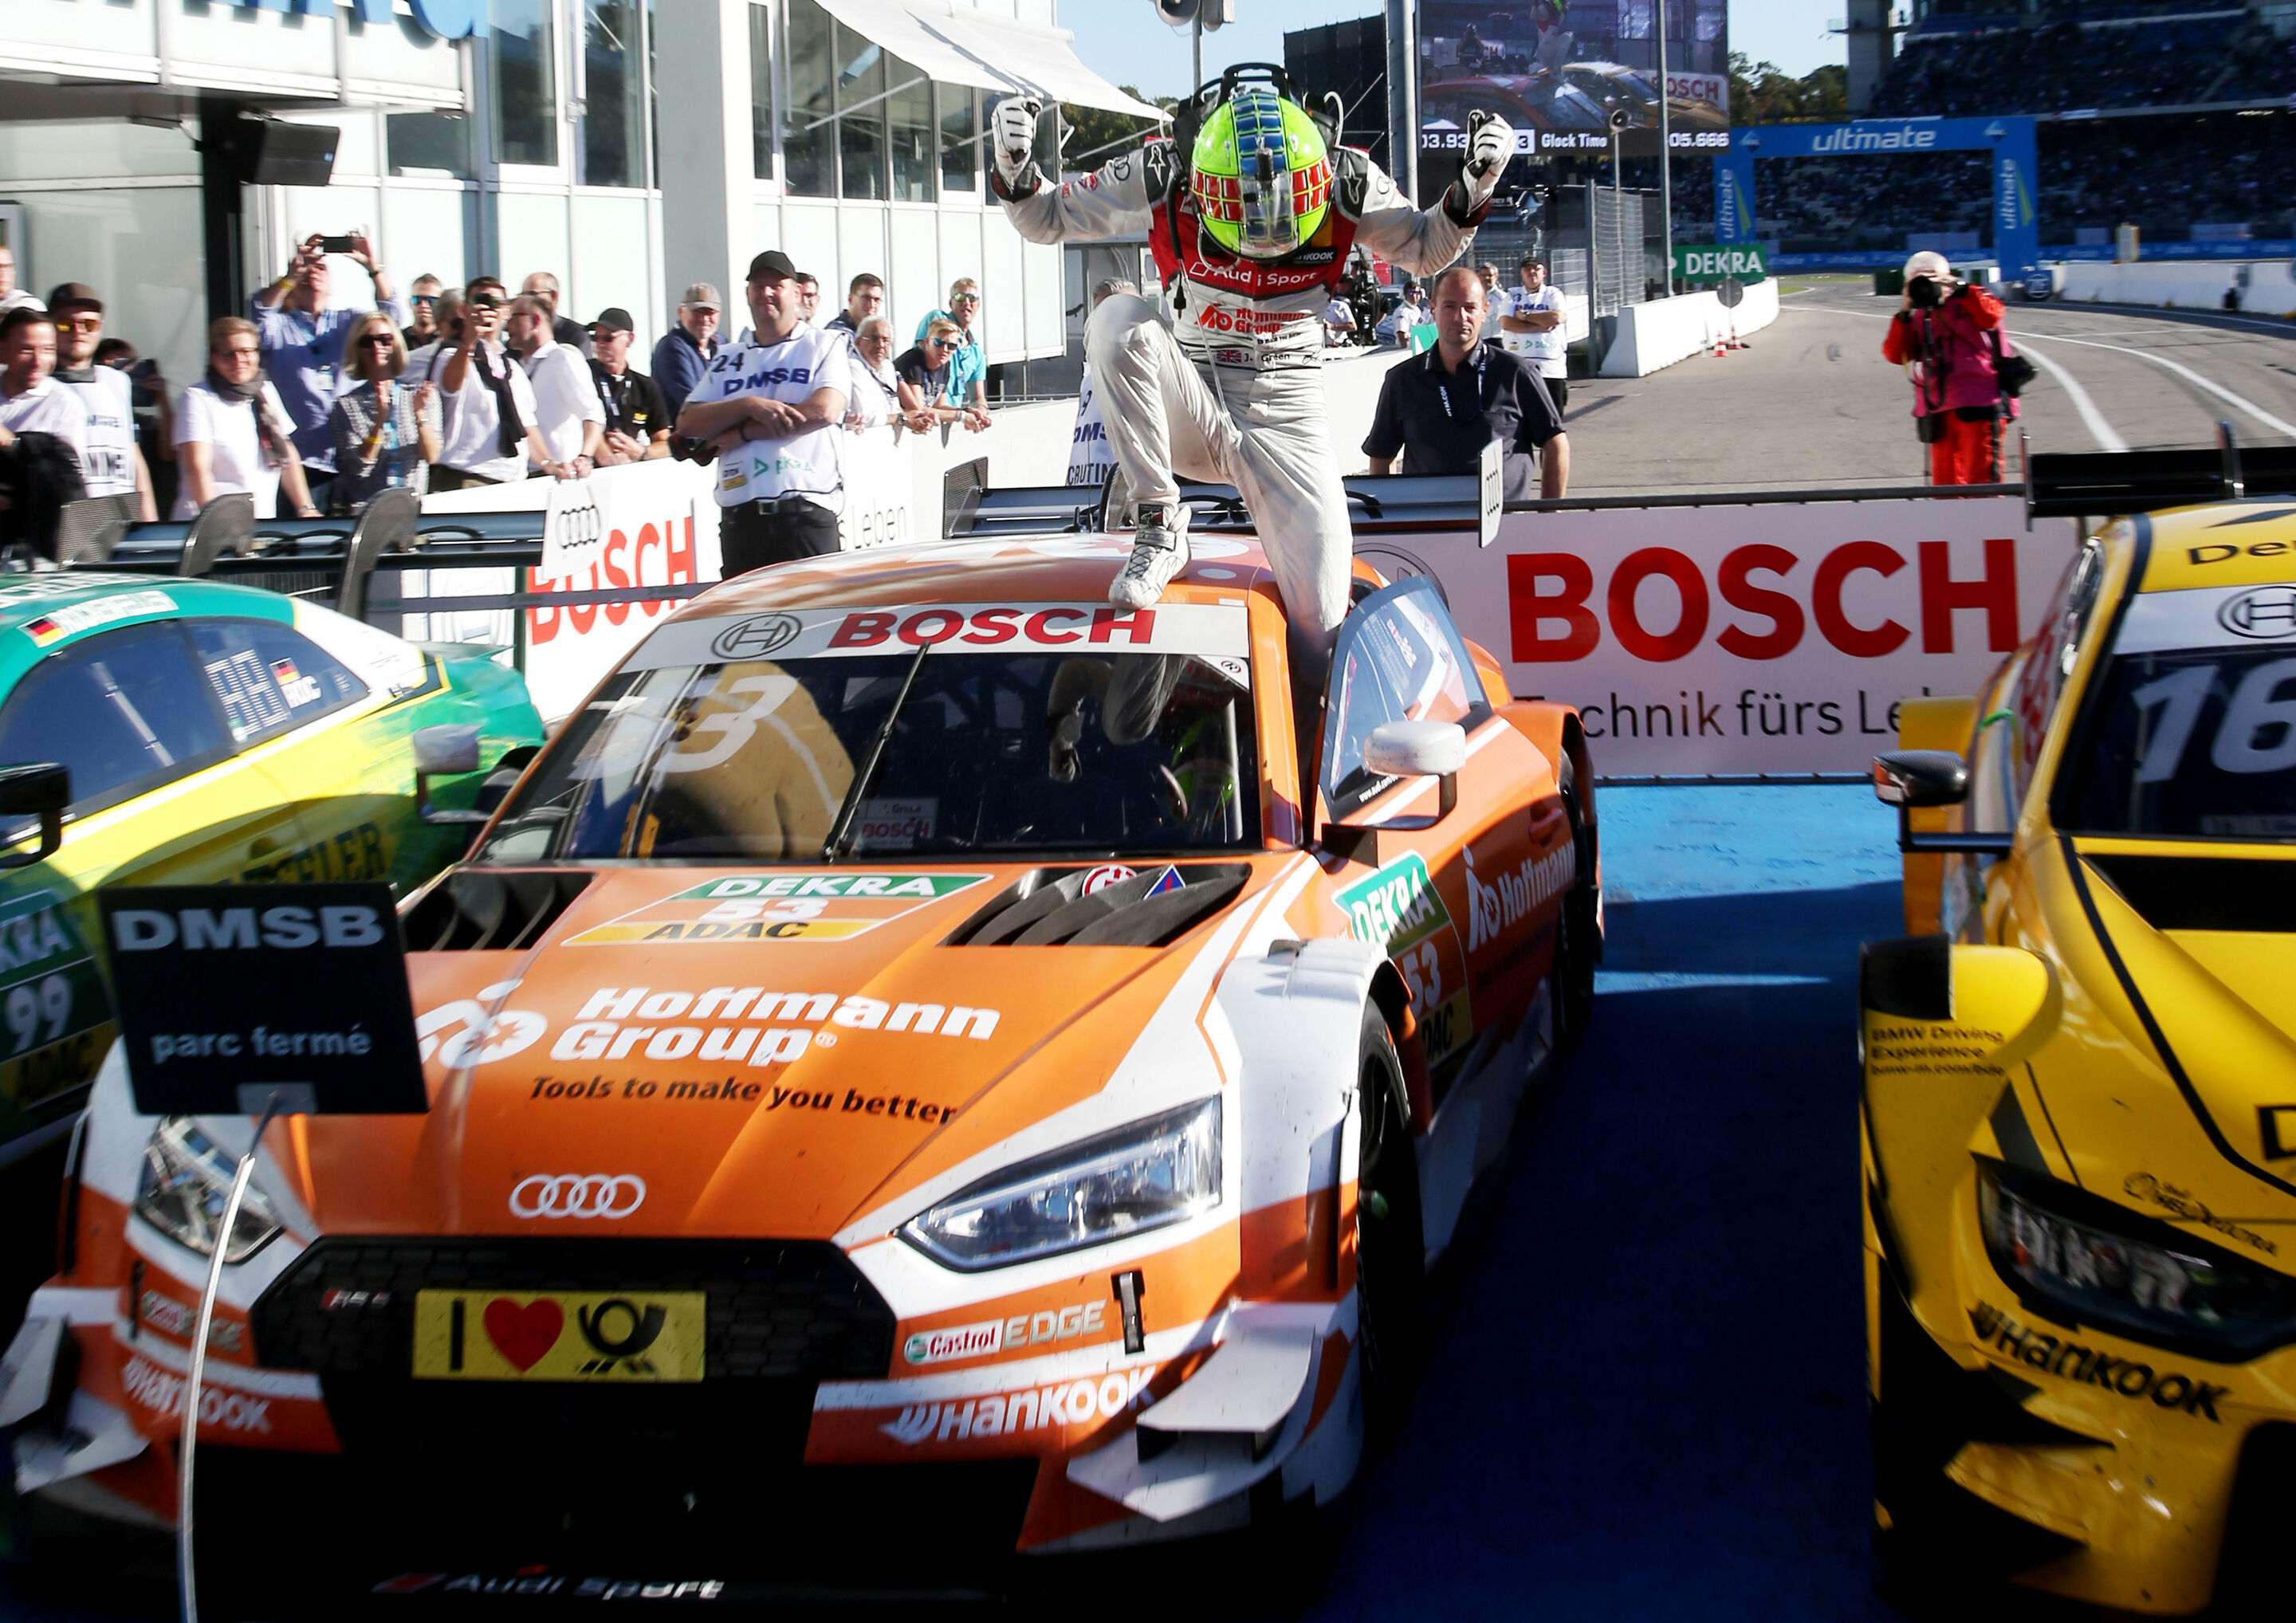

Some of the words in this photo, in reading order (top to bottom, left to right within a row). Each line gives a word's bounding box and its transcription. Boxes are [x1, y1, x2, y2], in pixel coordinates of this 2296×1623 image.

[1813, 126, 1936, 151] ultimate
[1718, 169, 1733, 239] ultimate
[2000, 159, 2018, 230] ultimate
[1214, 266, 1262, 286] Audi
[1266, 273, 1317, 286] Sport
[1686, 253, 1763, 274] DEKRA
[713, 352, 745, 371] 24
[1261, 353, 1290, 363] Green
[724, 368, 810, 396] DMSB
[852, 500, 906, 550] Leben
[1507, 540, 2019, 663] BOSCH
[828, 609, 1155, 647] BOSCH
[1736, 689, 1843, 737] fürs
[2131, 658, 2296, 783] 16
[863, 823, 930, 838] BOSCH
[707, 876, 936, 897] DEKRA
[1351, 867, 1435, 944] DEKRA
[1498, 839, 1576, 927] Hoffmann
[112, 906, 385, 951] DMSB
[642, 922, 810, 939] ADAC
[698, 898, 829, 921] 53
[1402, 941, 1441, 1017] 53
[6, 973, 73, 1054] 99
[575, 986, 1001, 1040] Hoffmann
[151, 1032, 242, 1064] parc
[250, 1023, 372, 1056] fermé
[529, 1076, 611, 1100] Tools
[622, 1078, 657, 1098] to
[665, 1077, 761, 1101] make
[765, 1084, 835, 1111] you
[841, 1088, 957, 1126] better
[930, 1326, 997, 1357] Castrol
[1003, 1299, 1107, 1350] EDGE
[444, 1574, 566, 1594] Audi
